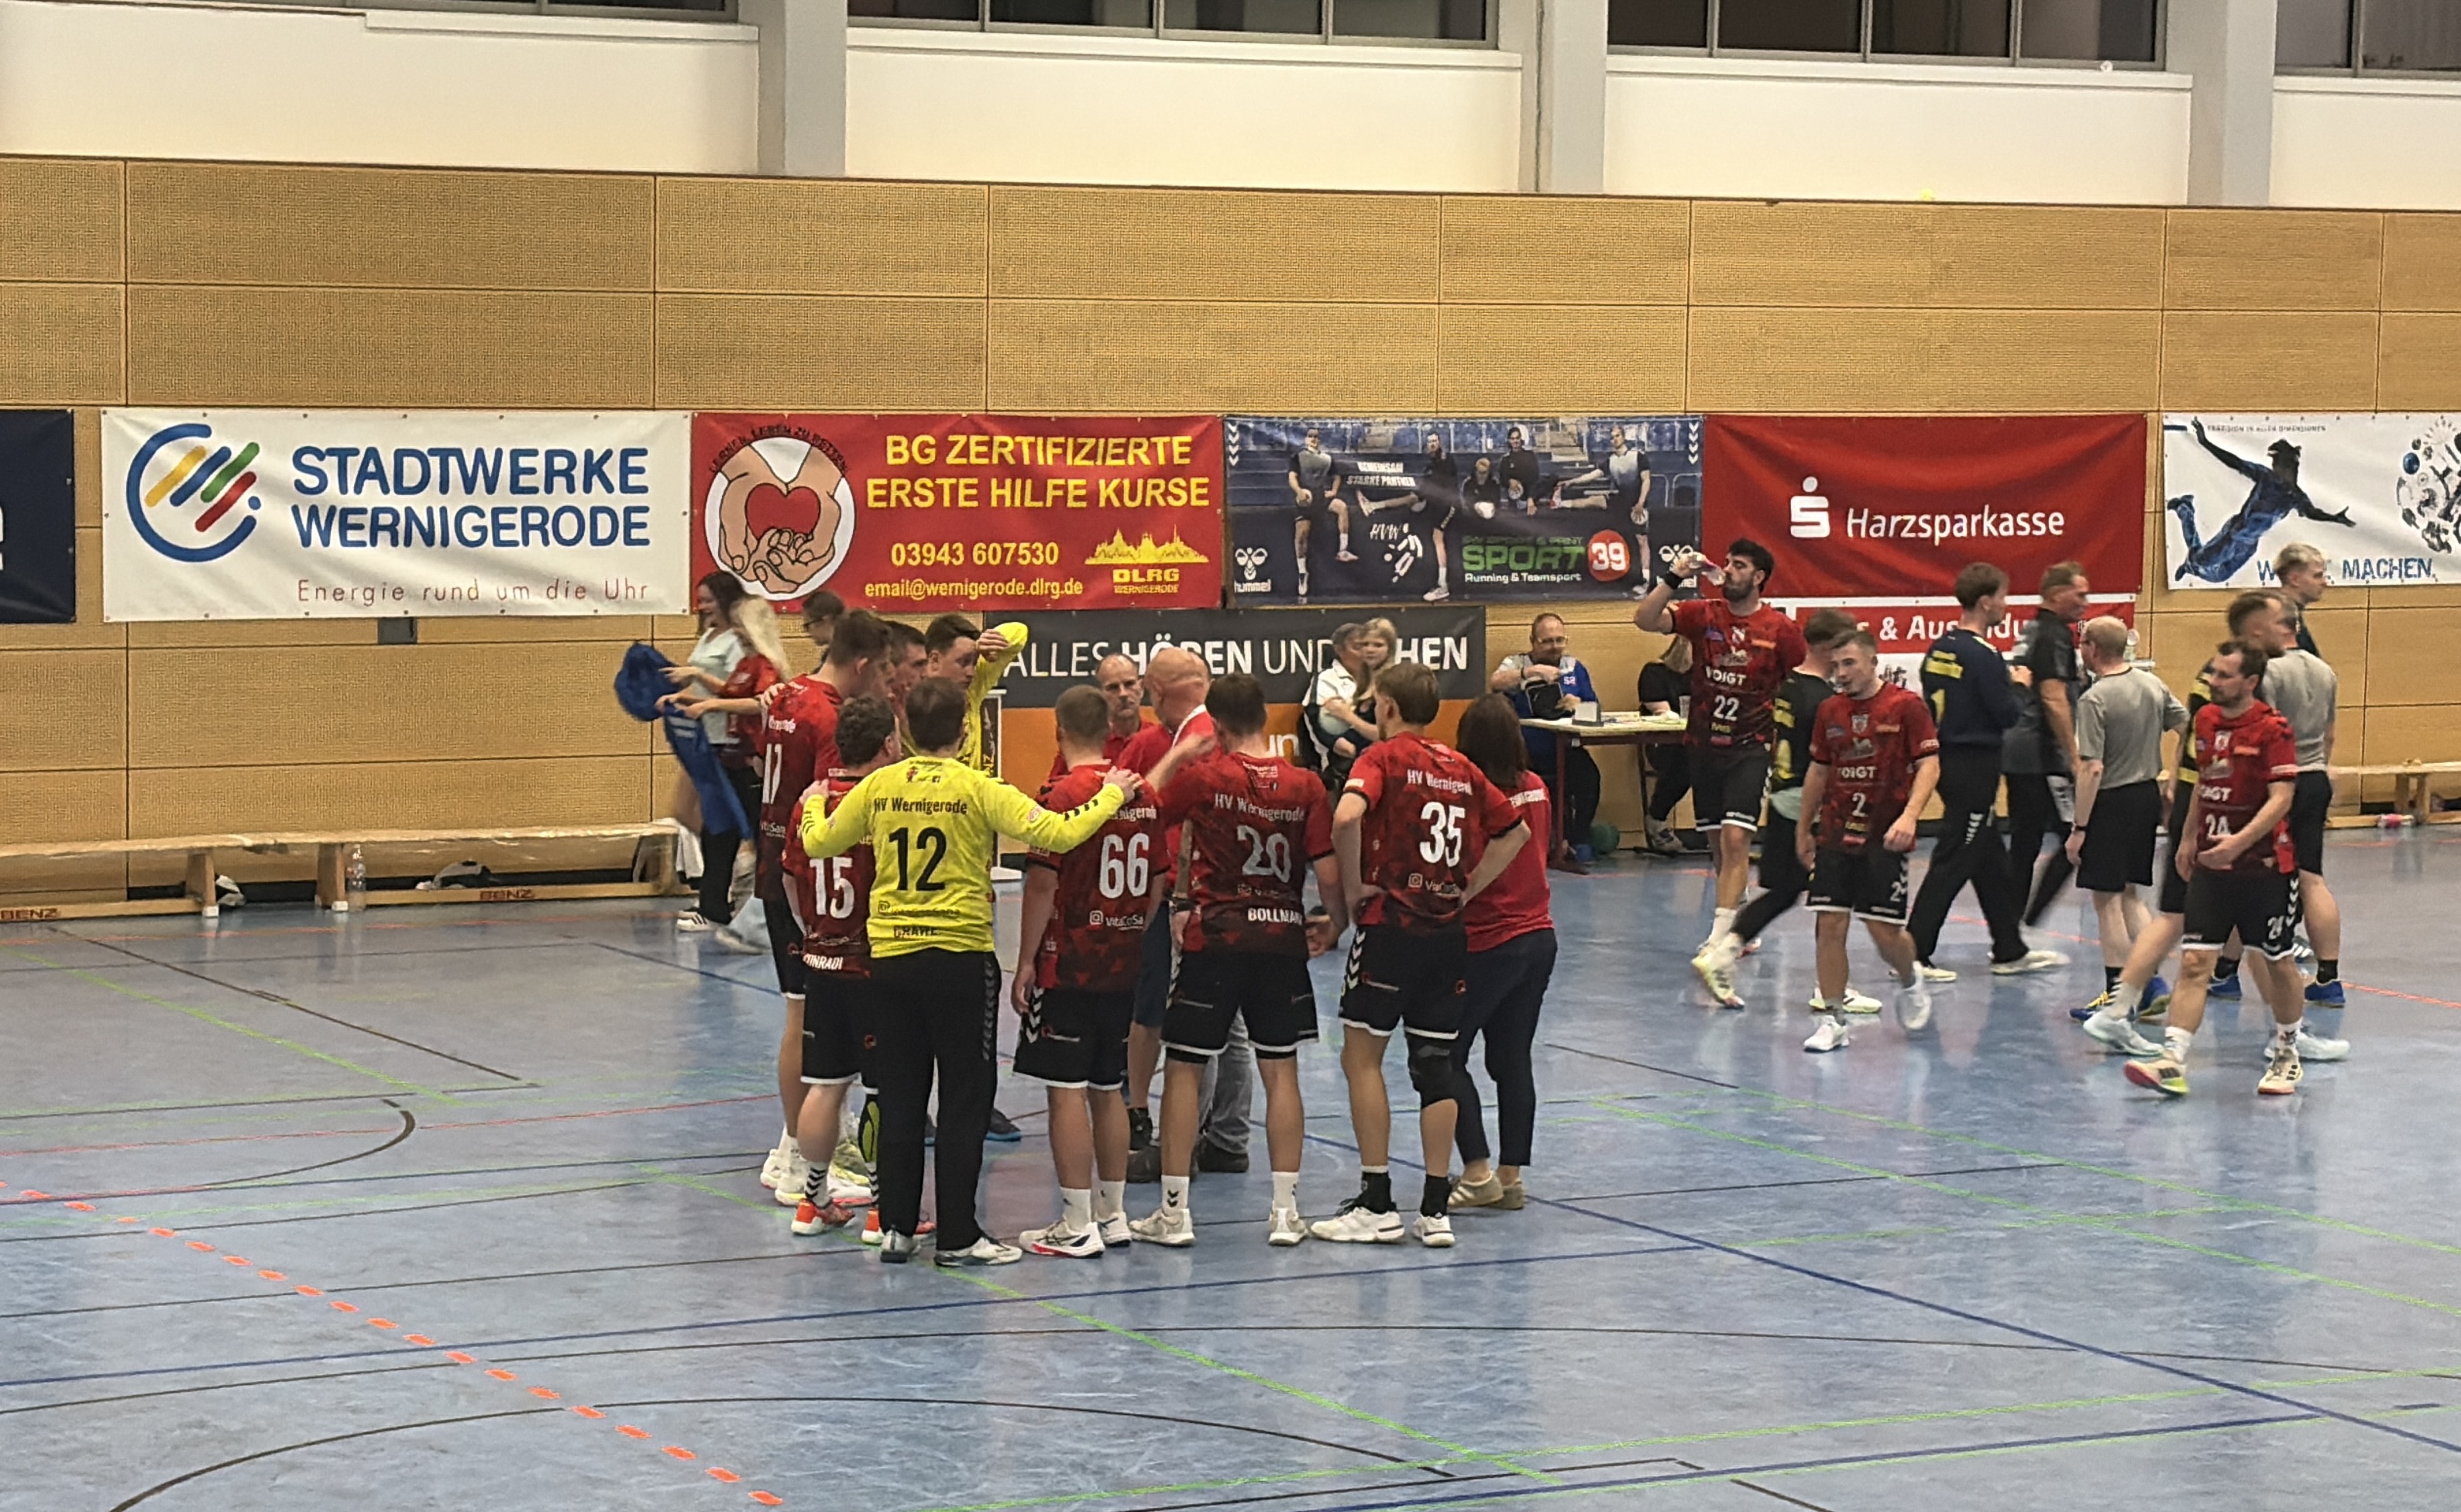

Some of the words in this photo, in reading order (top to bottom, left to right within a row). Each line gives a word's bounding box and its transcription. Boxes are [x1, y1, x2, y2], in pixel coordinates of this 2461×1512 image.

[886, 436, 936, 466] BG
[946, 436, 1193, 466] ZERTIFIZIERTE
[292, 446, 649, 495] STADTWERKE
[868, 479, 979, 508] ERSTE
[991, 479, 1088, 507] HILFE
[1099, 477, 1209, 507] KURSE
[291, 504, 651, 548] WERNIGERODE
[1847, 504, 2065, 545] Harzsparkasse
[891, 542, 964, 566] 03943
[972, 542, 1059, 565] 607530
[1463, 545, 1585, 571] SPORT
[1592, 542, 1626, 571] 39
[864, 578, 1083, 600] email@wernigerode.dlrg.de
[1113, 569, 1179, 582] DLRG
[1465, 572, 1508, 584] Running
[1521, 572, 1582, 583] Teamsport
[297, 579, 404, 607] Energie
[423, 579, 479, 601] rund
[497, 586, 530, 600] um
[546, 579, 586, 600] die
[605, 578, 648, 600] Uhr
[1879, 617, 1898, 641] &
[1713, 695, 1740, 721] 22
[1408, 769, 1424, 785] HV
[892, 797, 968, 816] Wernigerode
[1215, 792, 1233, 808] HV
[1237, 796, 1305, 822] Wernigerode
[1851, 792, 1868, 818] 2
[1419, 801, 1466, 867] 35
[889, 827, 947, 891] 12
[1099, 833, 1150, 899] 66
[1237, 825, 1292, 883] 20
[809, 857, 855, 919] 15
